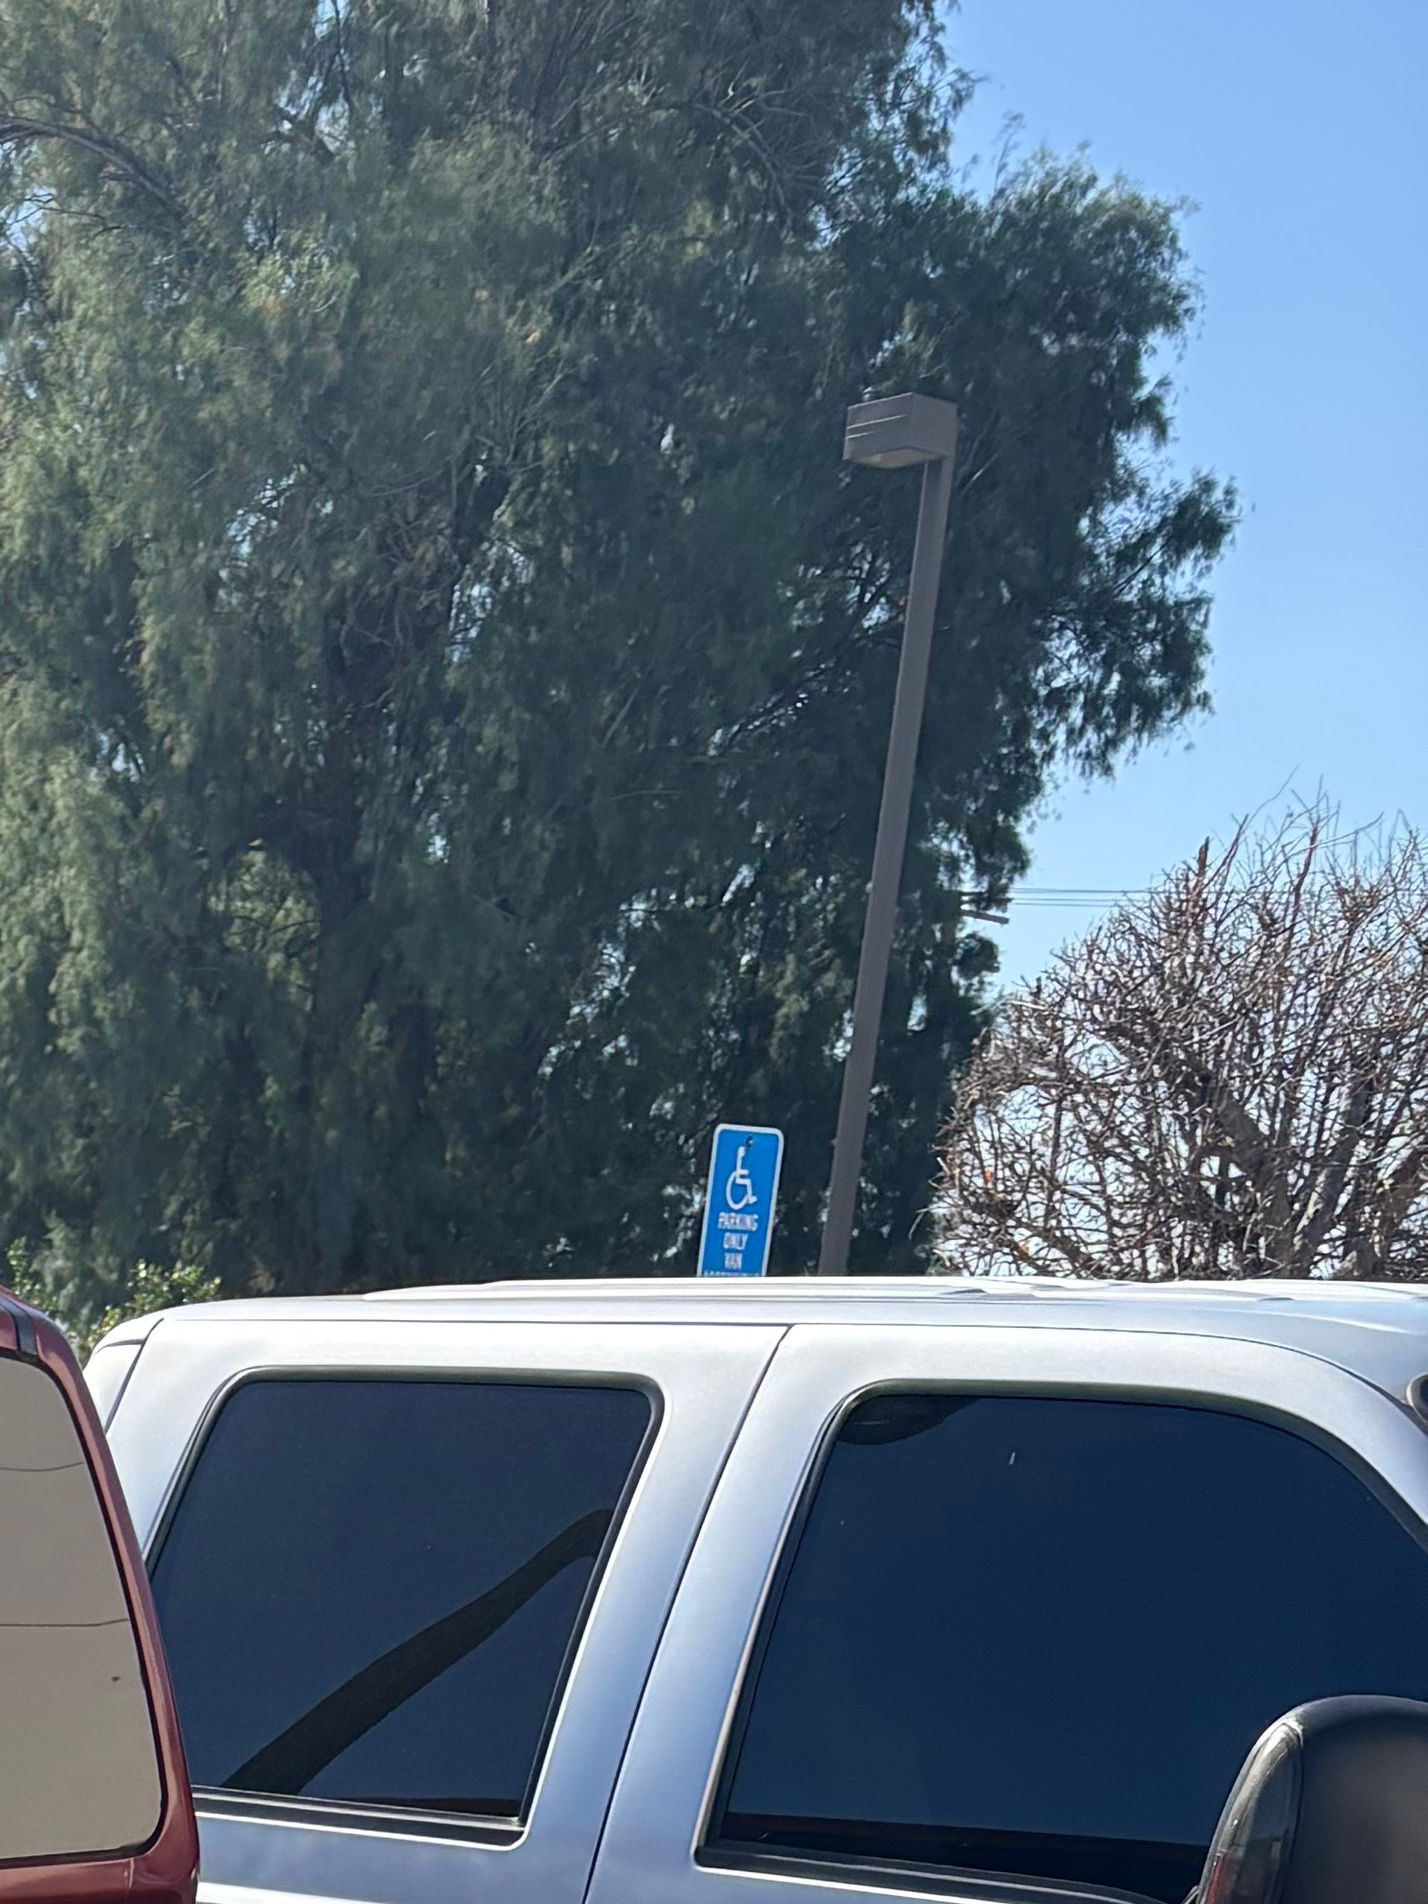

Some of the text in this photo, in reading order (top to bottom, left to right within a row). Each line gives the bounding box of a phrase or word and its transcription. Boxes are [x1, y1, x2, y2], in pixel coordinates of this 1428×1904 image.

[717, 1212, 759, 1231] PARKING
[723, 1232, 749, 1250] ONLY
[724, 1252, 743, 1270] VAN
